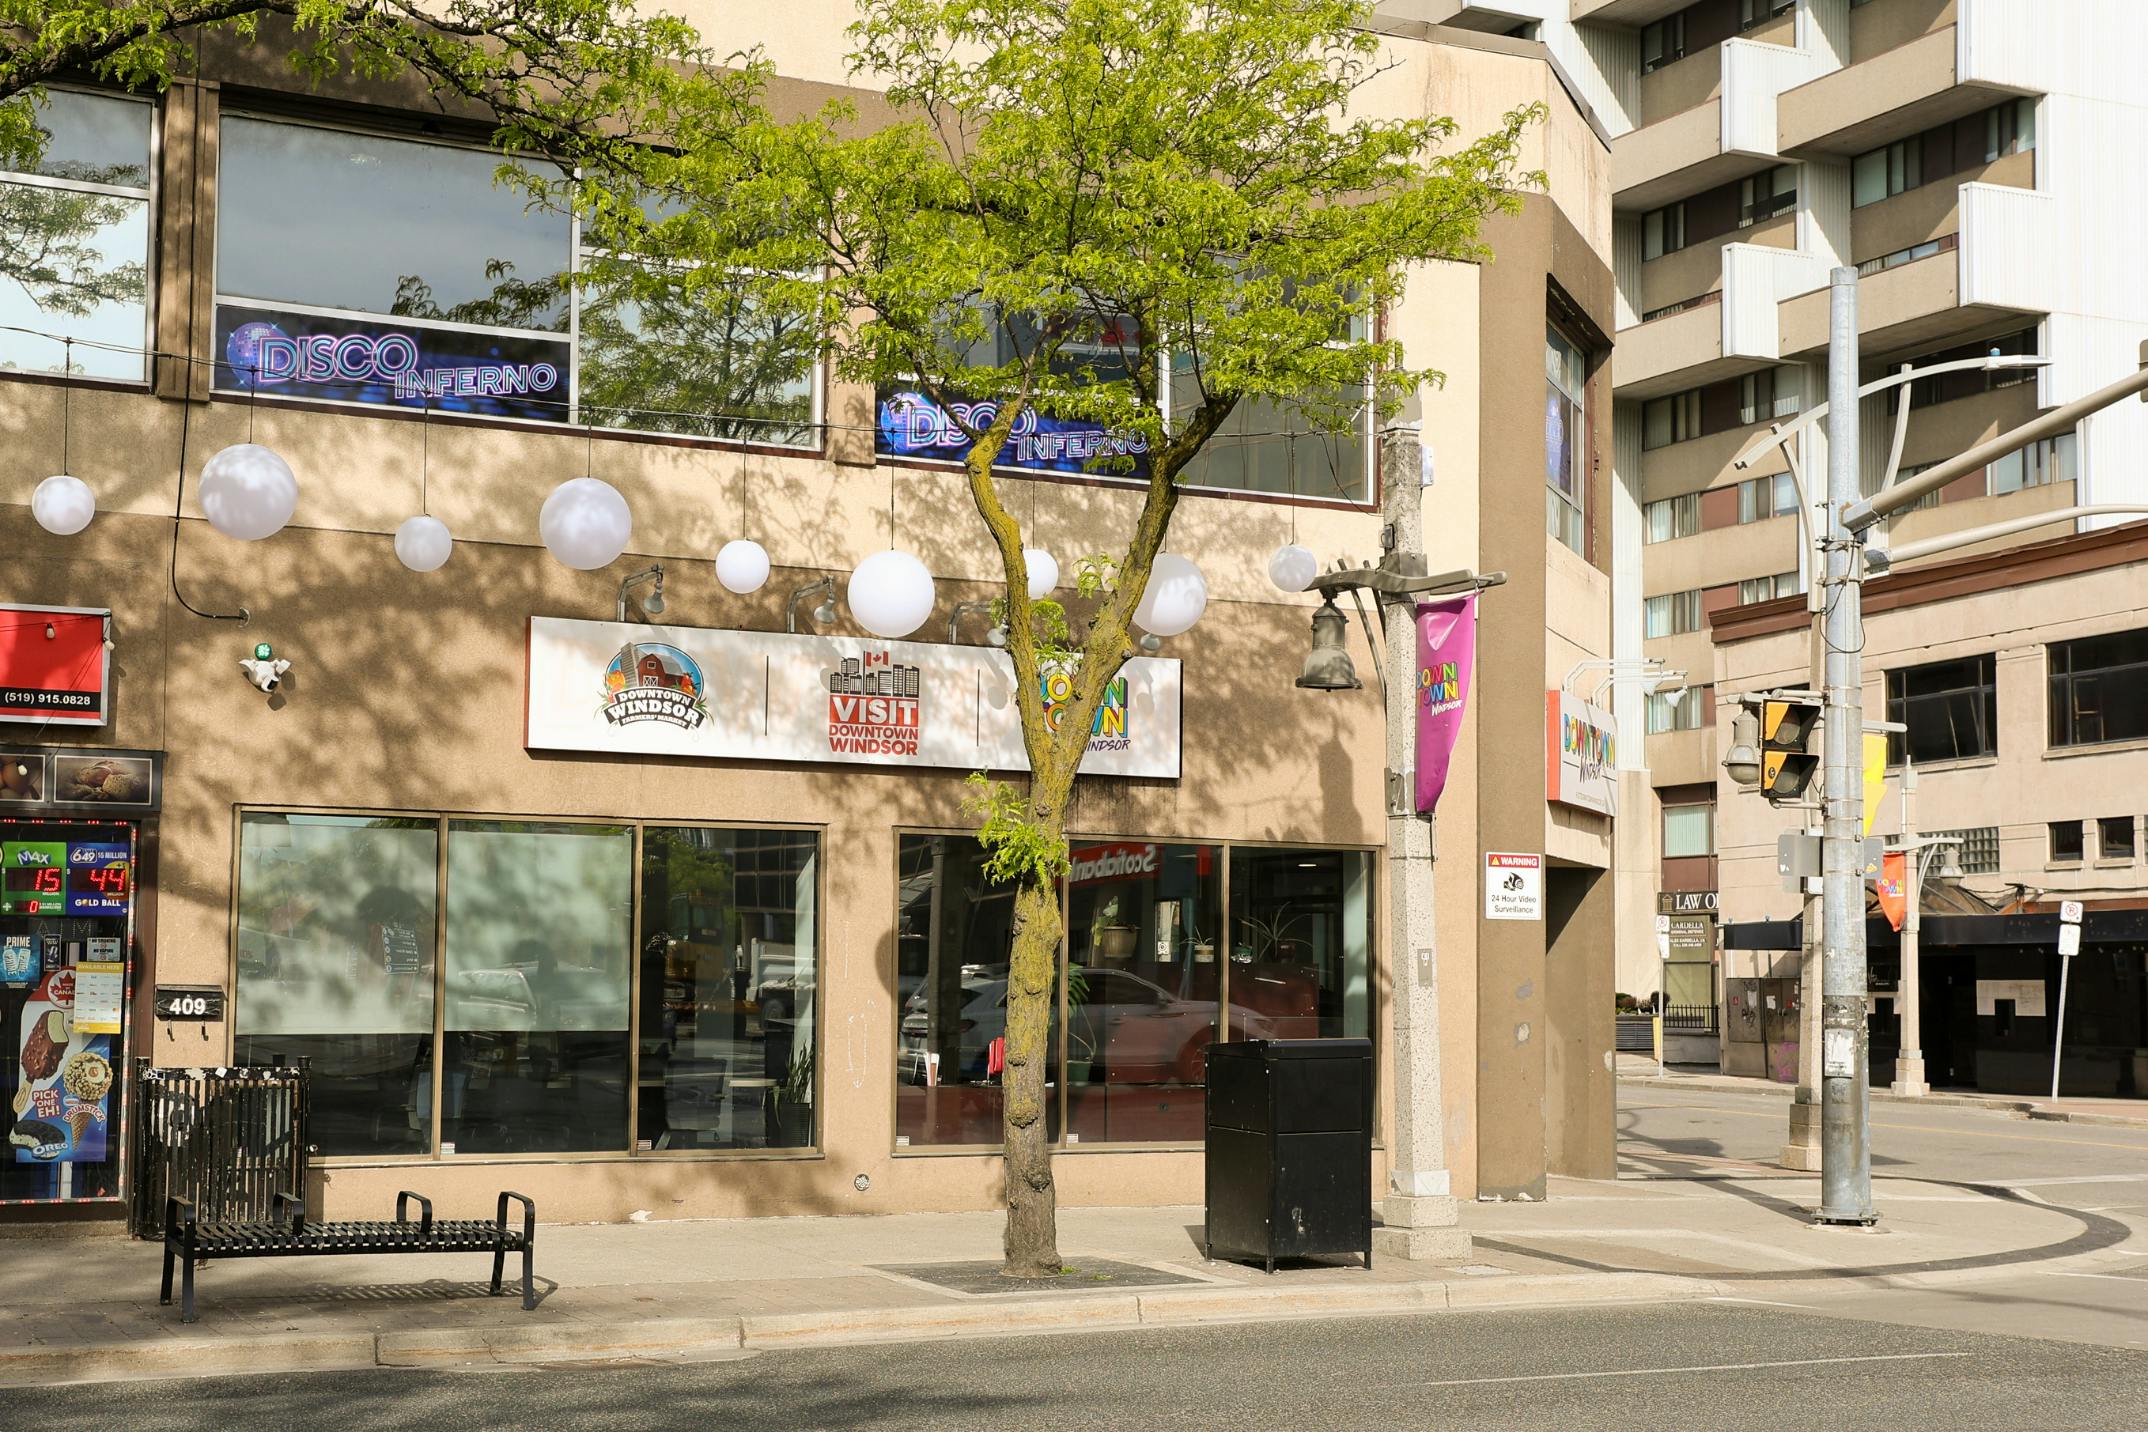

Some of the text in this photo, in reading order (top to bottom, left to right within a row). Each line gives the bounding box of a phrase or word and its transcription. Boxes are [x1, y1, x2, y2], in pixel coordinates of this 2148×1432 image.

[259, 334, 418, 383] DISCO
[395, 363, 557, 399] INFERNO
[1017, 429, 1148, 461] INFERNO
[4, 692, 91, 706] (519) 915.0828
[617, 688, 692, 706] DOWNTOWN
[607, 699, 700, 725] WINDSOR
[832, 696, 917, 726] VISIT
[657, 714, 687, 728] MARKET
[829, 724, 919, 741] DOWNTOWN
[829, 737, 918, 756] WINDSOR
[1086, 739, 1131, 752] INDSOR
[17, 850, 49, 865] MAX
[1500, 856, 1537, 866] WARNING
[34, 868, 61, 892] 15
[90, 868, 126, 892] 44
[29, 900, 39, 913] 0
[1491, 895, 1537, 904] 24 Hour Video
[1676, 894, 1702, 910] LAW
[1494, 905, 1534, 914] Surveillance
[6, 936, 31, 947] PRIME
[169, 997, 206, 1015] 409
[33, 1089, 59, 1100] PICK
[37, 1099, 56, 1108] ONE
[37, 1106, 60, 1118] EH!
[63, 1103, 106, 1124] DRUMSTICK
[32, 1143, 68, 1155] OREO
